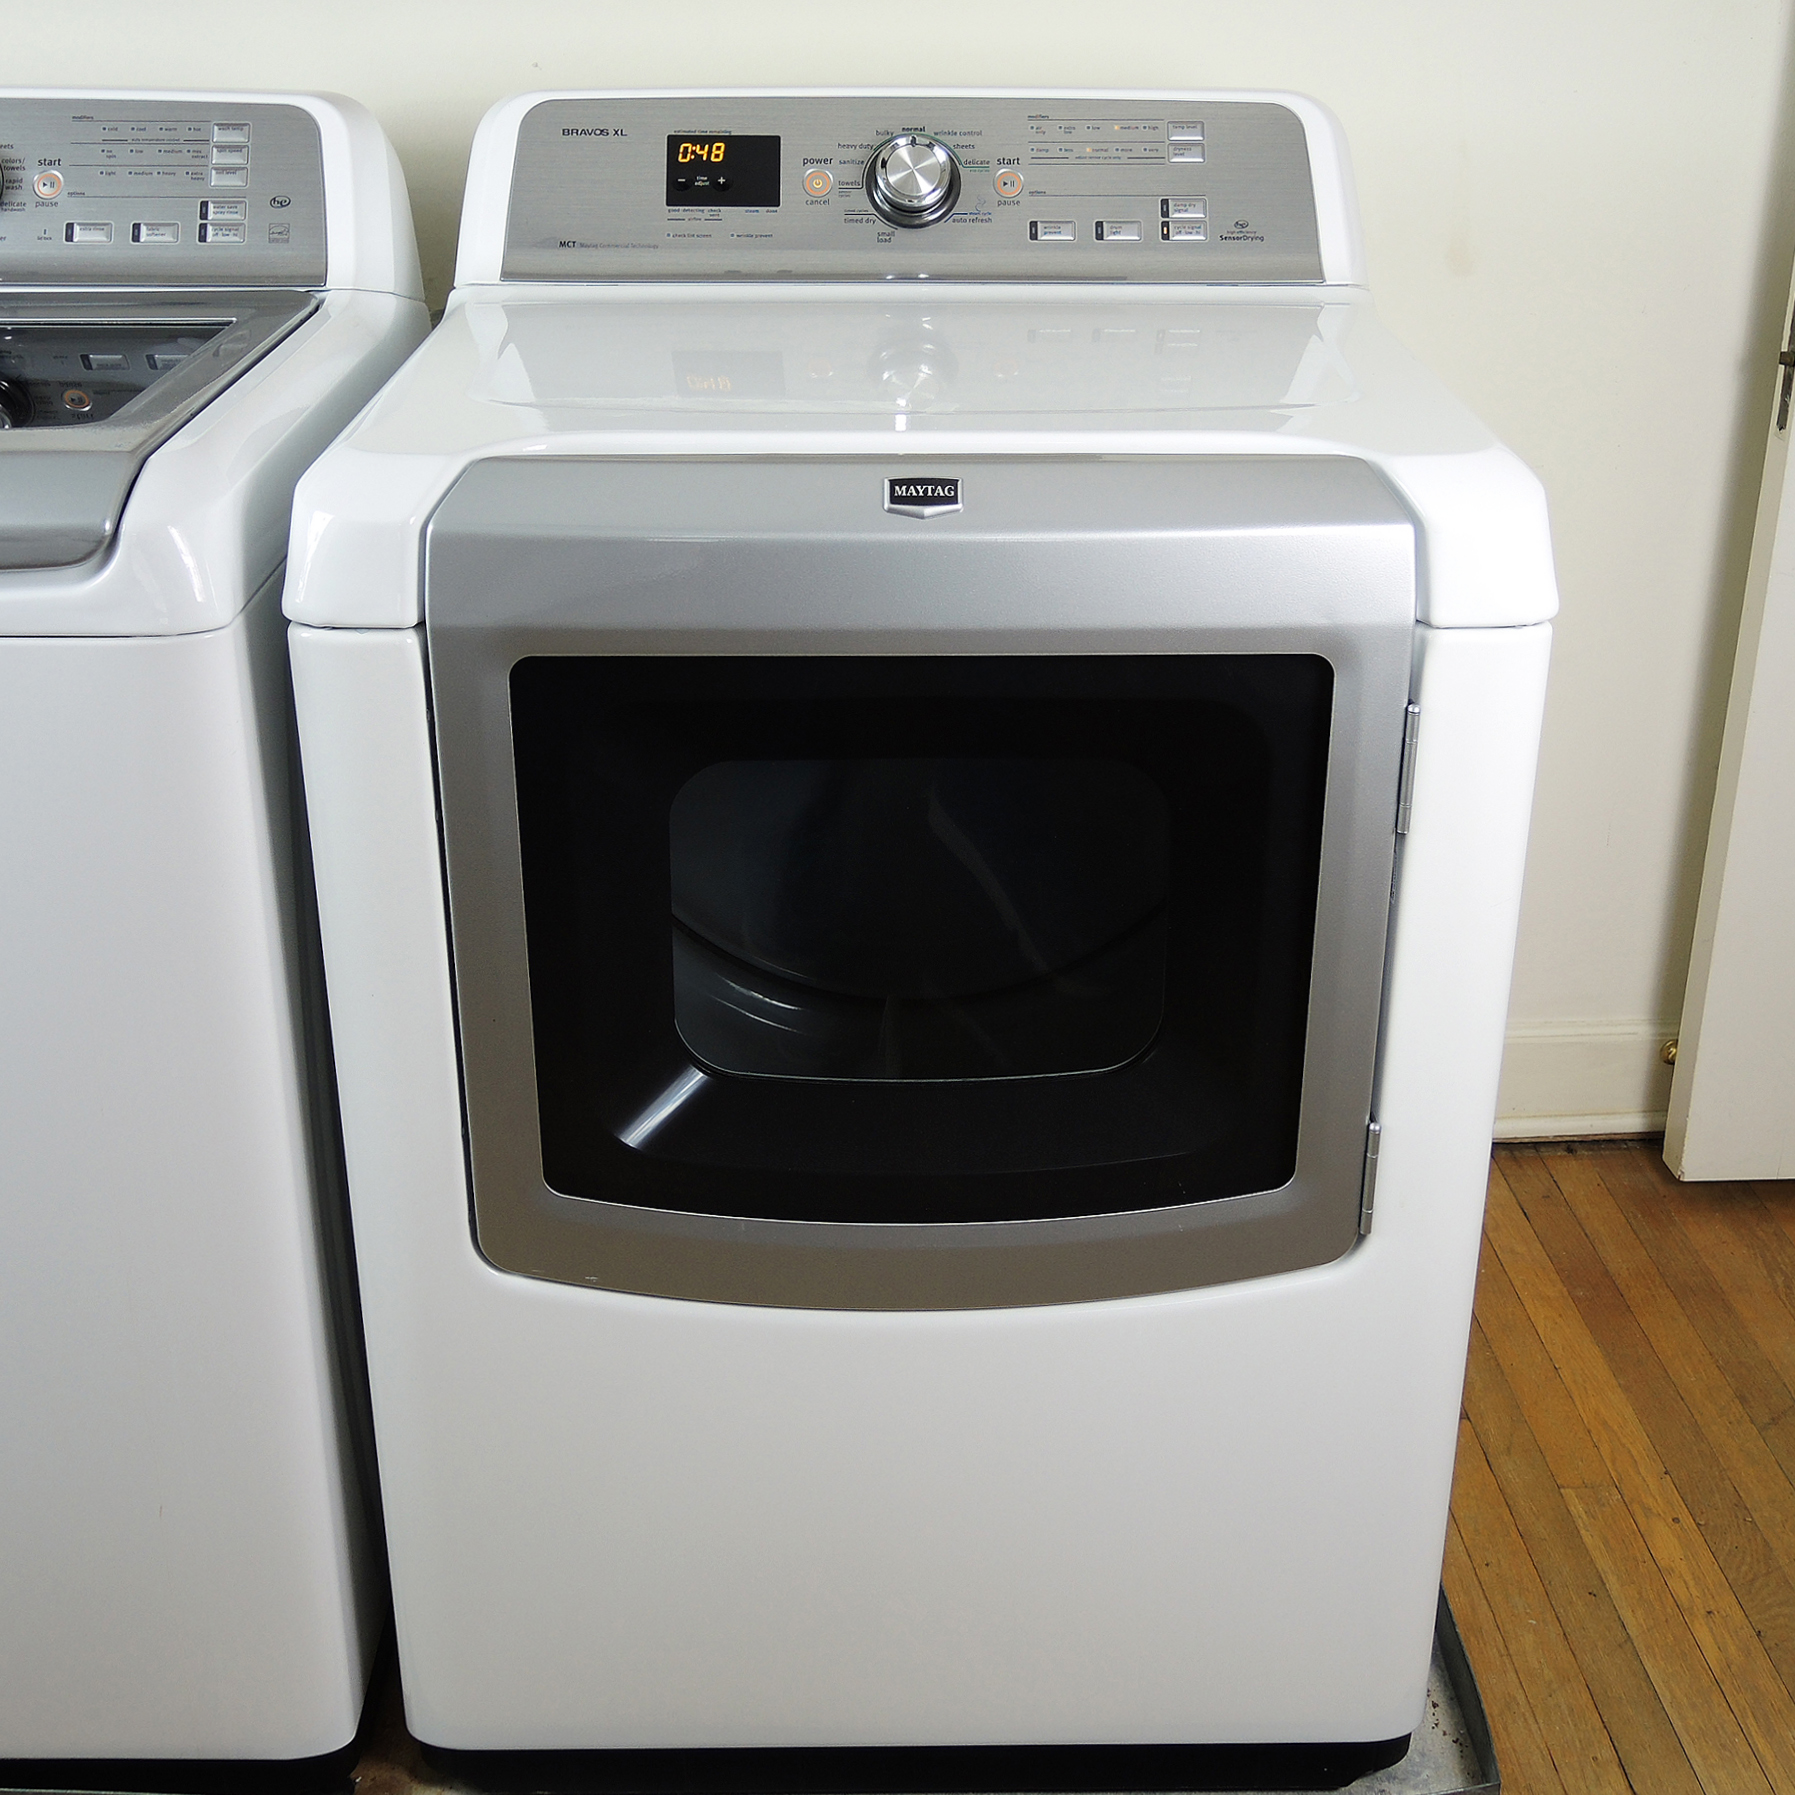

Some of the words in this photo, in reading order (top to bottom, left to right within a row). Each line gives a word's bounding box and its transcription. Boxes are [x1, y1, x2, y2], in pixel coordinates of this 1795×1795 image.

[562, 129, 610, 137] BRAVOS
[612, 129, 628, 137] XL
[875, 129, 894, 137] bulky
[678, 142, 725, 163] 0:48
[37, 158, 62, 167] start
[802, 157, 833, 167] power
[996, 157, 1021, 165] start
[5, 177, 23, 185] rapid
[805, 198, 830, 206] cancel
[997, 199, 1021, 207] pause
[1219, 235, 1264, 243] SensorDrying
[558, 240, 577, 249] MCT
[894, 485, 955, 497] MAYTAG
